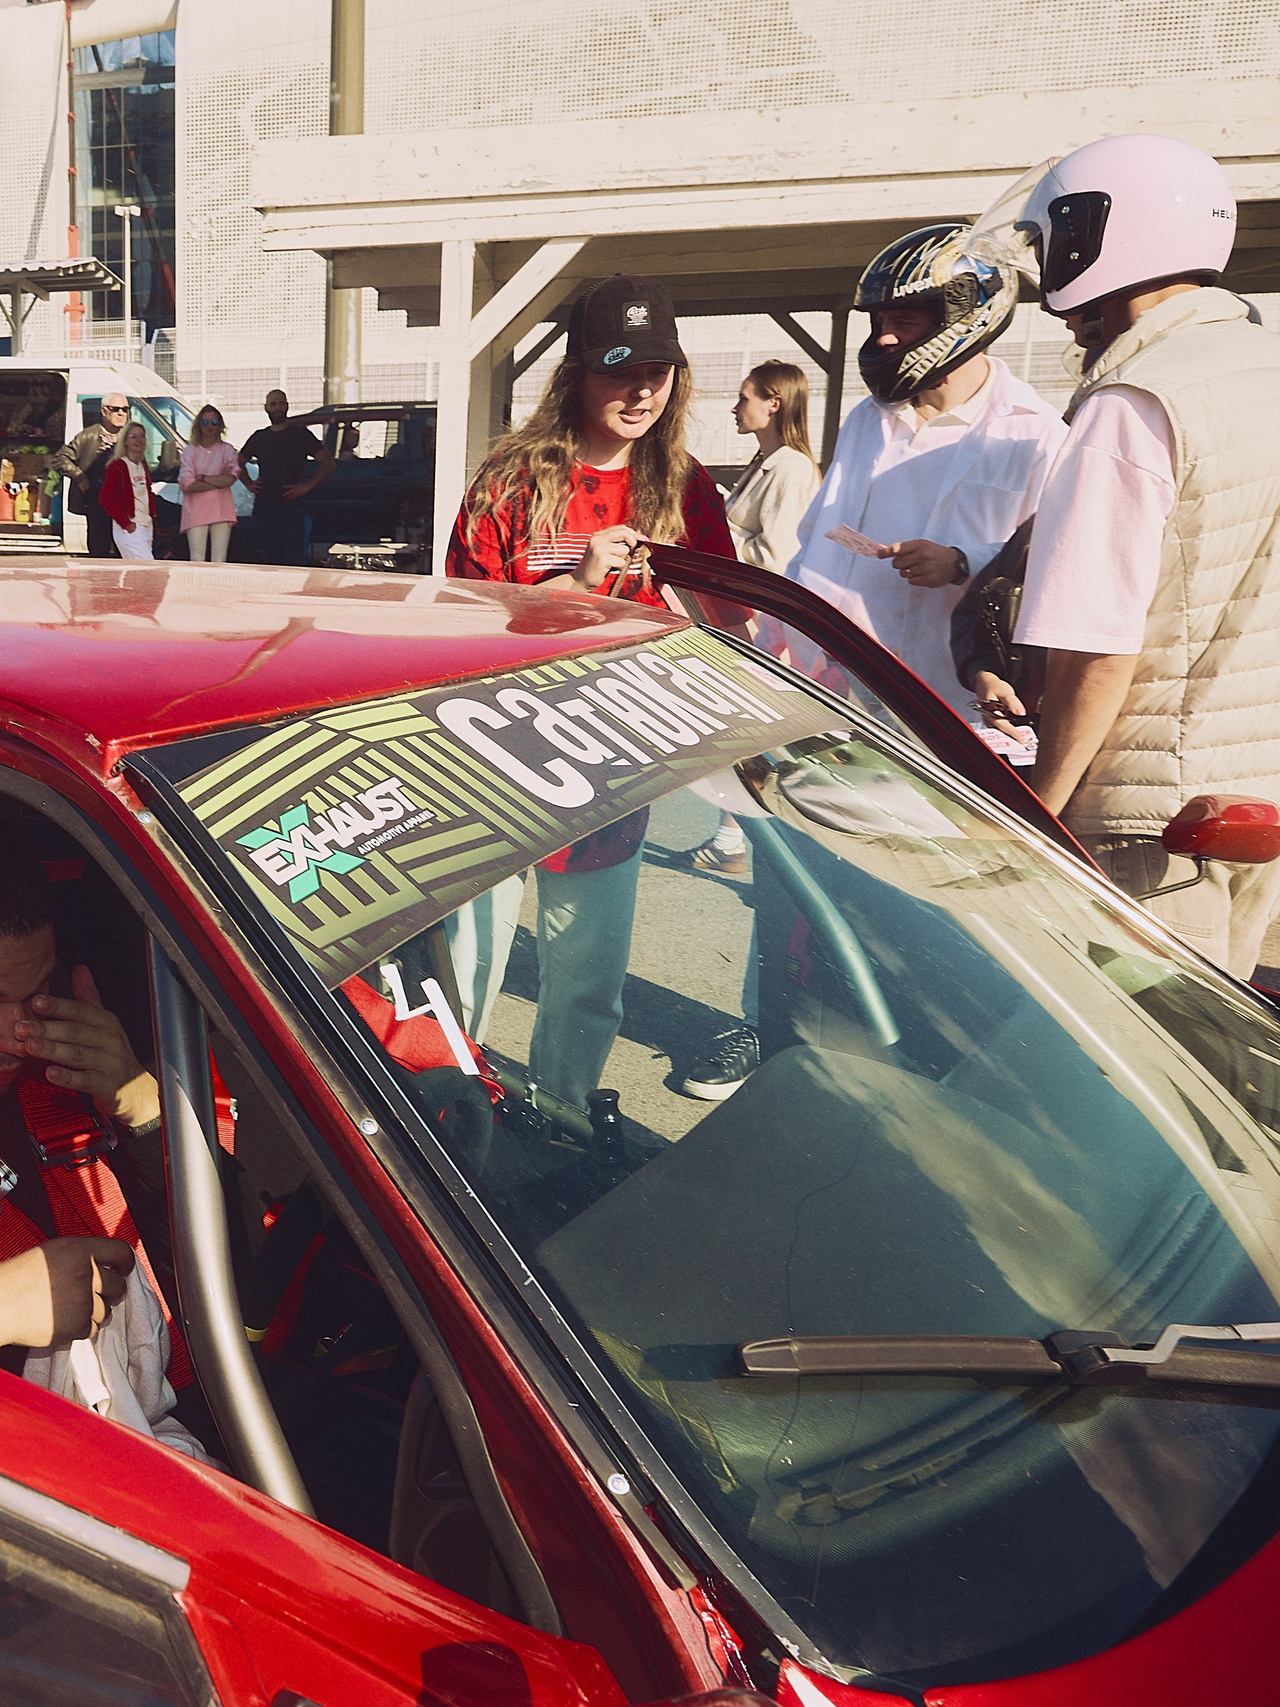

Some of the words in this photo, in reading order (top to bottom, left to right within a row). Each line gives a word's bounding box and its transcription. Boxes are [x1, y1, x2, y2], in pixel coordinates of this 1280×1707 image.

[1212, 208, 1233, 219] HEL
[893, 275, 936, 298] uvex
[248, 776, 418, 886] EXHAUST
[356, 823, 407, 855] AUTOMOTIVE
[402, 808, 437, 832] APPAREL
